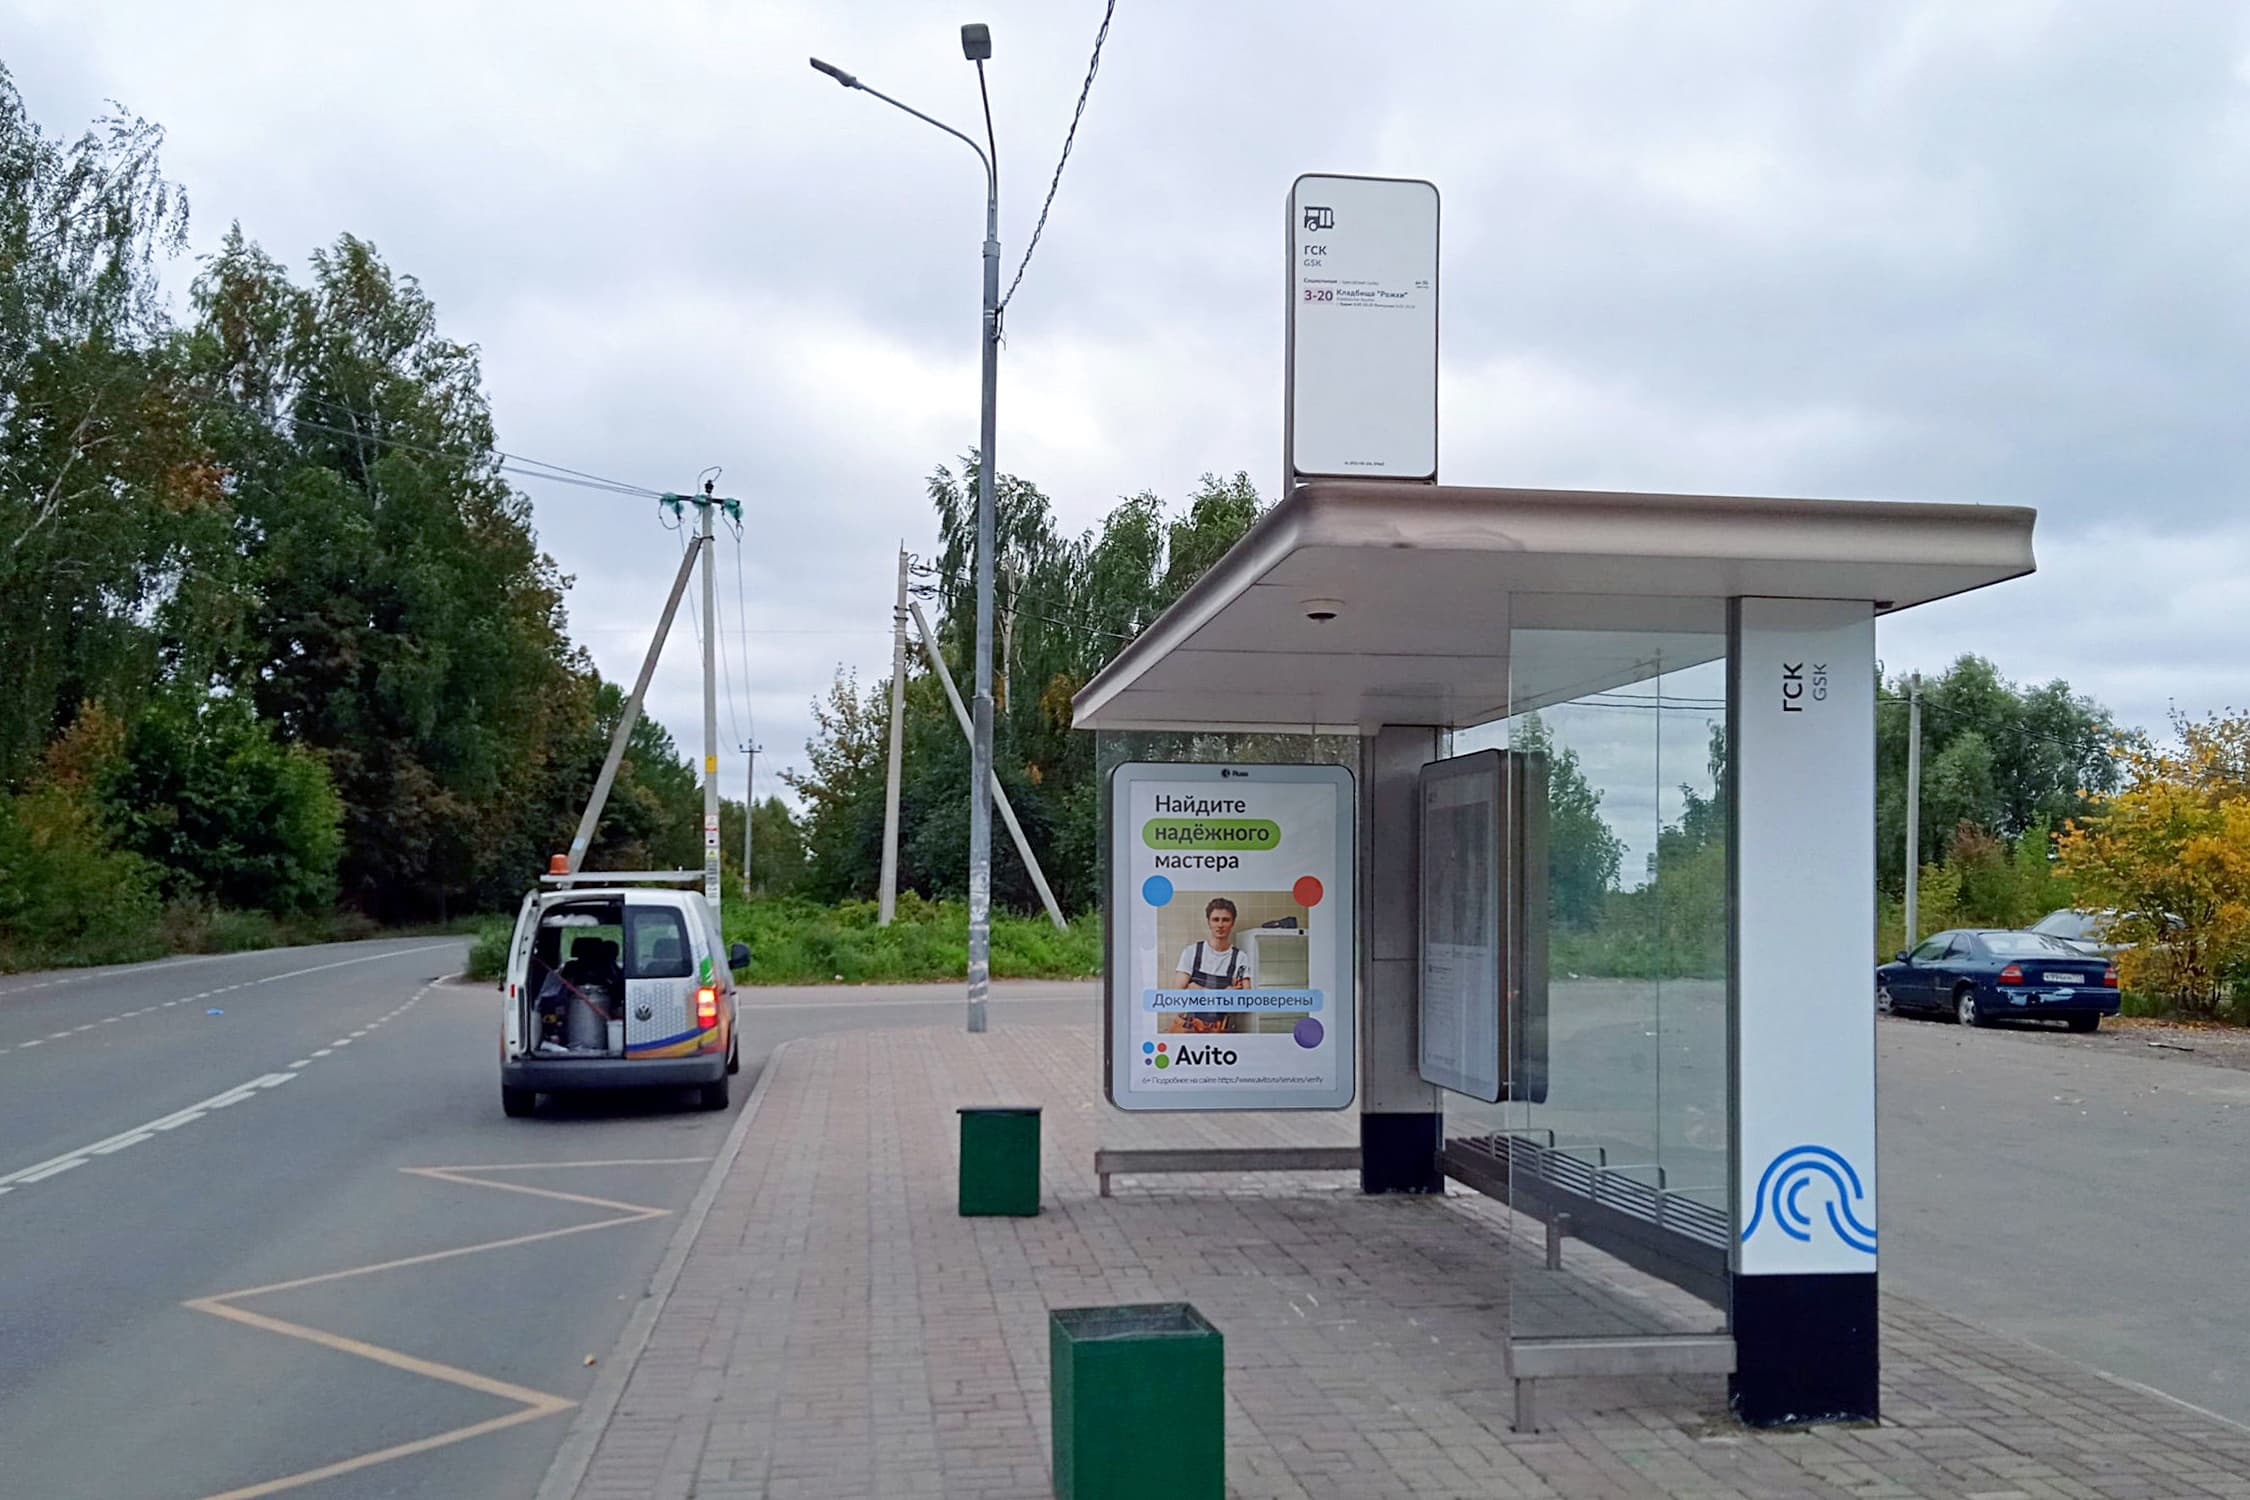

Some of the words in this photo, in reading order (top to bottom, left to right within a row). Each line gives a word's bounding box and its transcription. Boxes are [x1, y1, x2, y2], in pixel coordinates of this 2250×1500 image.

[1304, 245, 1327, 256] ГСК
[1303, 258, 1322, 267] GSK
[1304, 289, 1334, 301] 3-20
[1783, 662, 1803, 712] ГСК
[1813, 663, 1827, 701] GSK
[1155, 795, 1246, 816] Найдите
[1155, 823, 1270, 844] надёжного
[1155, 855, 1239, 872] мастера
[1152, 993, 1234, 1008] Документы
[1237, 995, 1313, 1008] проверены
[1175, 1045, 1238, 1066] Avito
